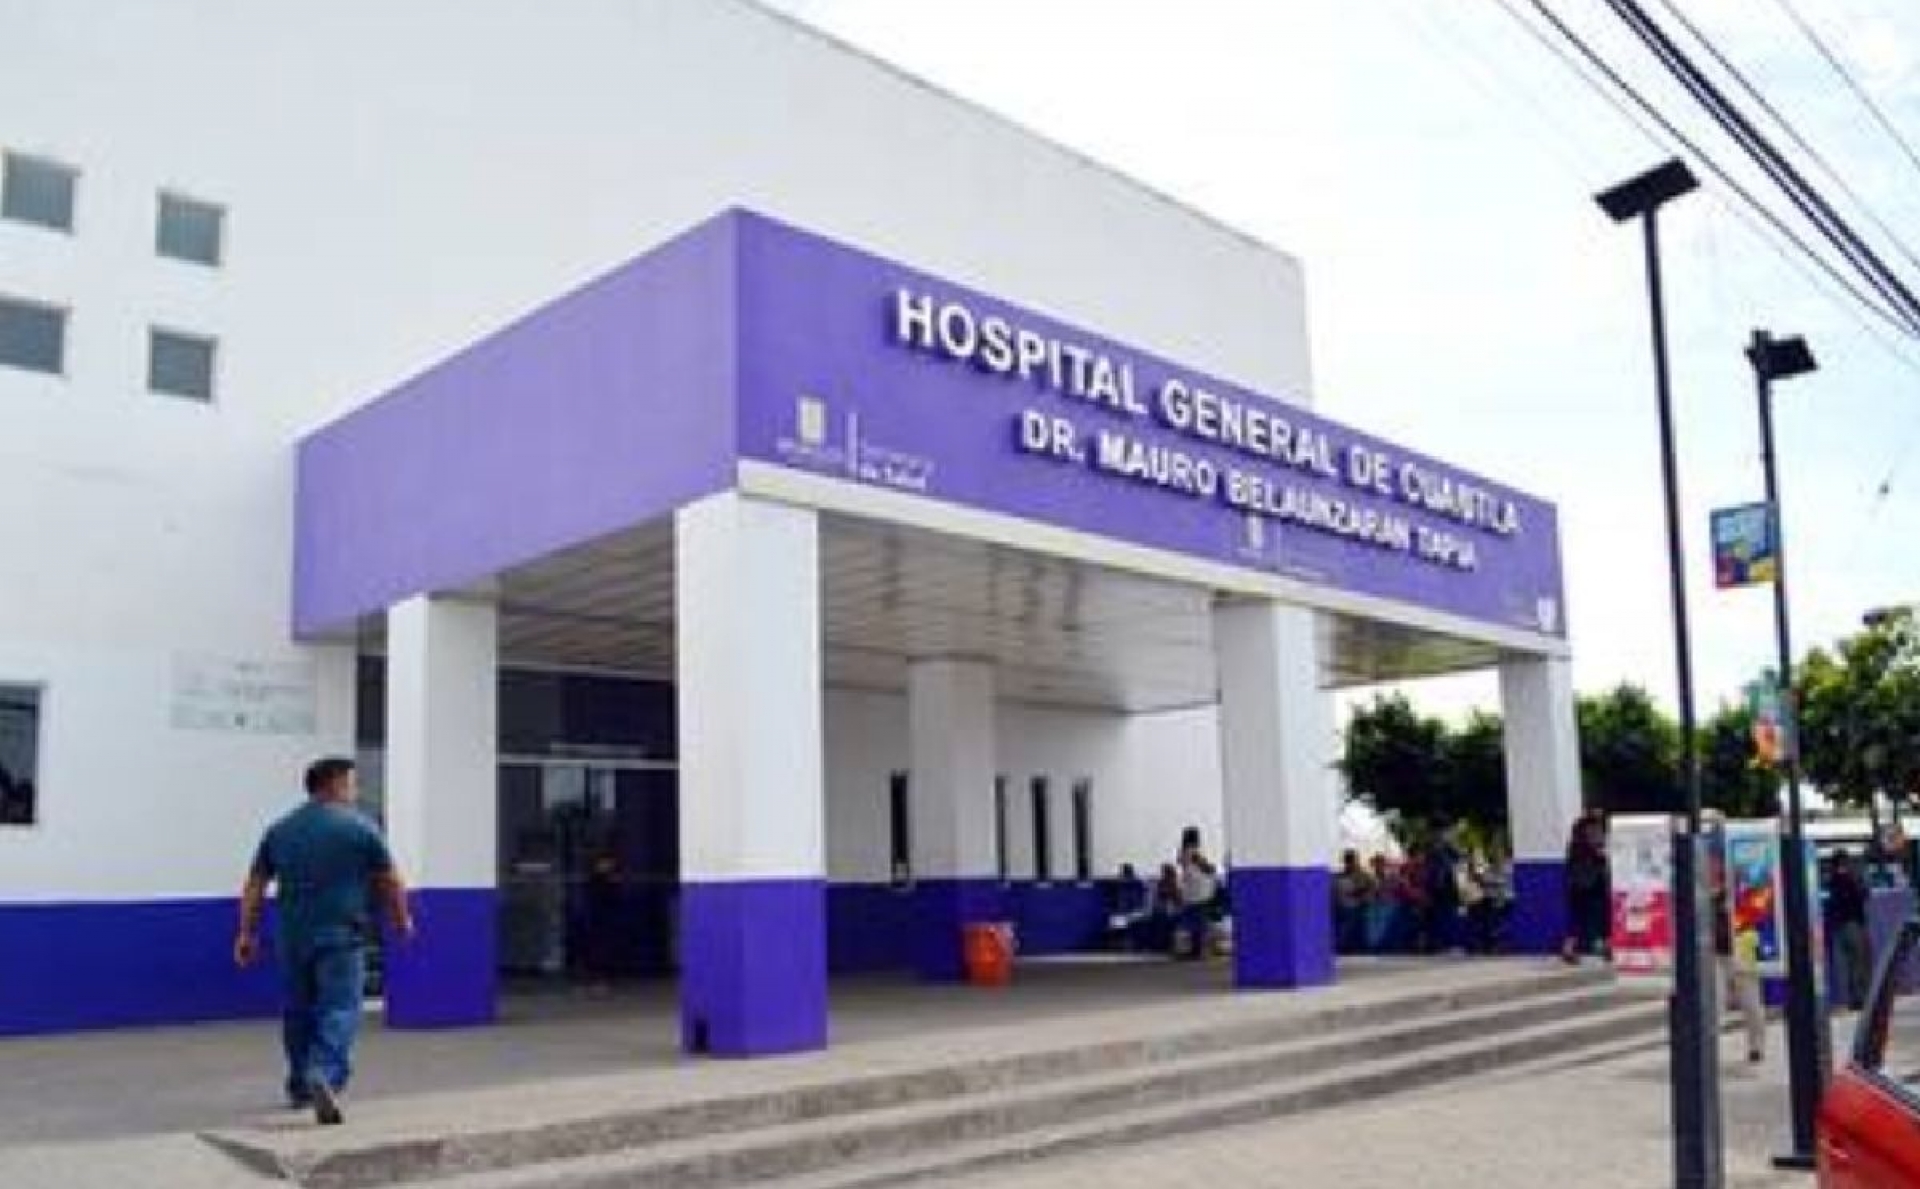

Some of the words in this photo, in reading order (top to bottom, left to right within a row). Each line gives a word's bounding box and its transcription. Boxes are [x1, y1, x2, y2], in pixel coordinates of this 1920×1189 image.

[898, 288, 1149, 415] HOSPITAL
[1161, 379, 1338, 476] GENERAL
[1350, 444, 1392, 494] DE
[1401, 462, 1522, 534] CUANTLA
[1022, 409, 1085, 462] DR.
[1098, 428, 1216, 495] MAURO
